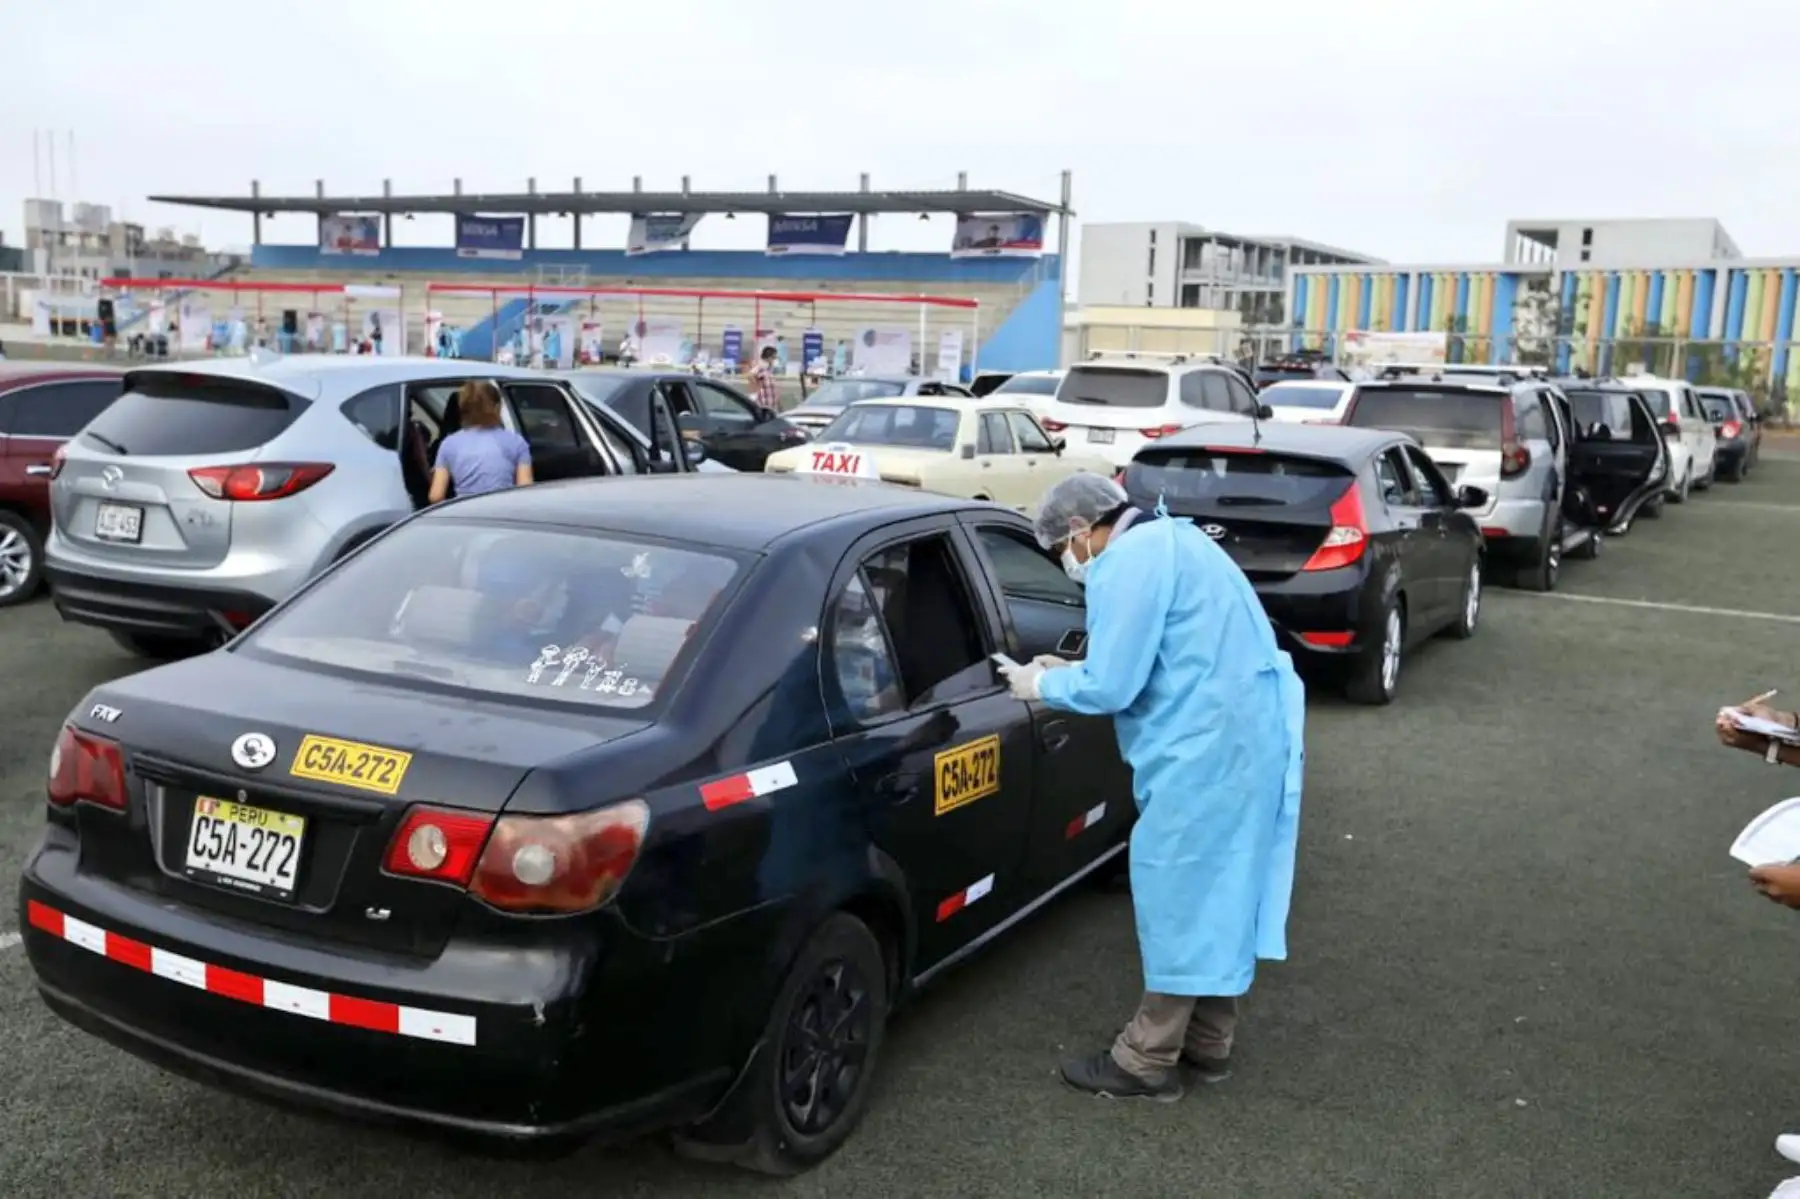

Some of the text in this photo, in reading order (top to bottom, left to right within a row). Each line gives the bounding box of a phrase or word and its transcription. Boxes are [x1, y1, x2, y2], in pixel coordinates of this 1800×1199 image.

[812, 451, 861, 474] TAXI
[304, 743, 398, 783] C5A-272
[941, 746, 997, 801] C5A-272
[229, 804, 268, 826] PERU
[193, 815, 296, 878] C5A-272
